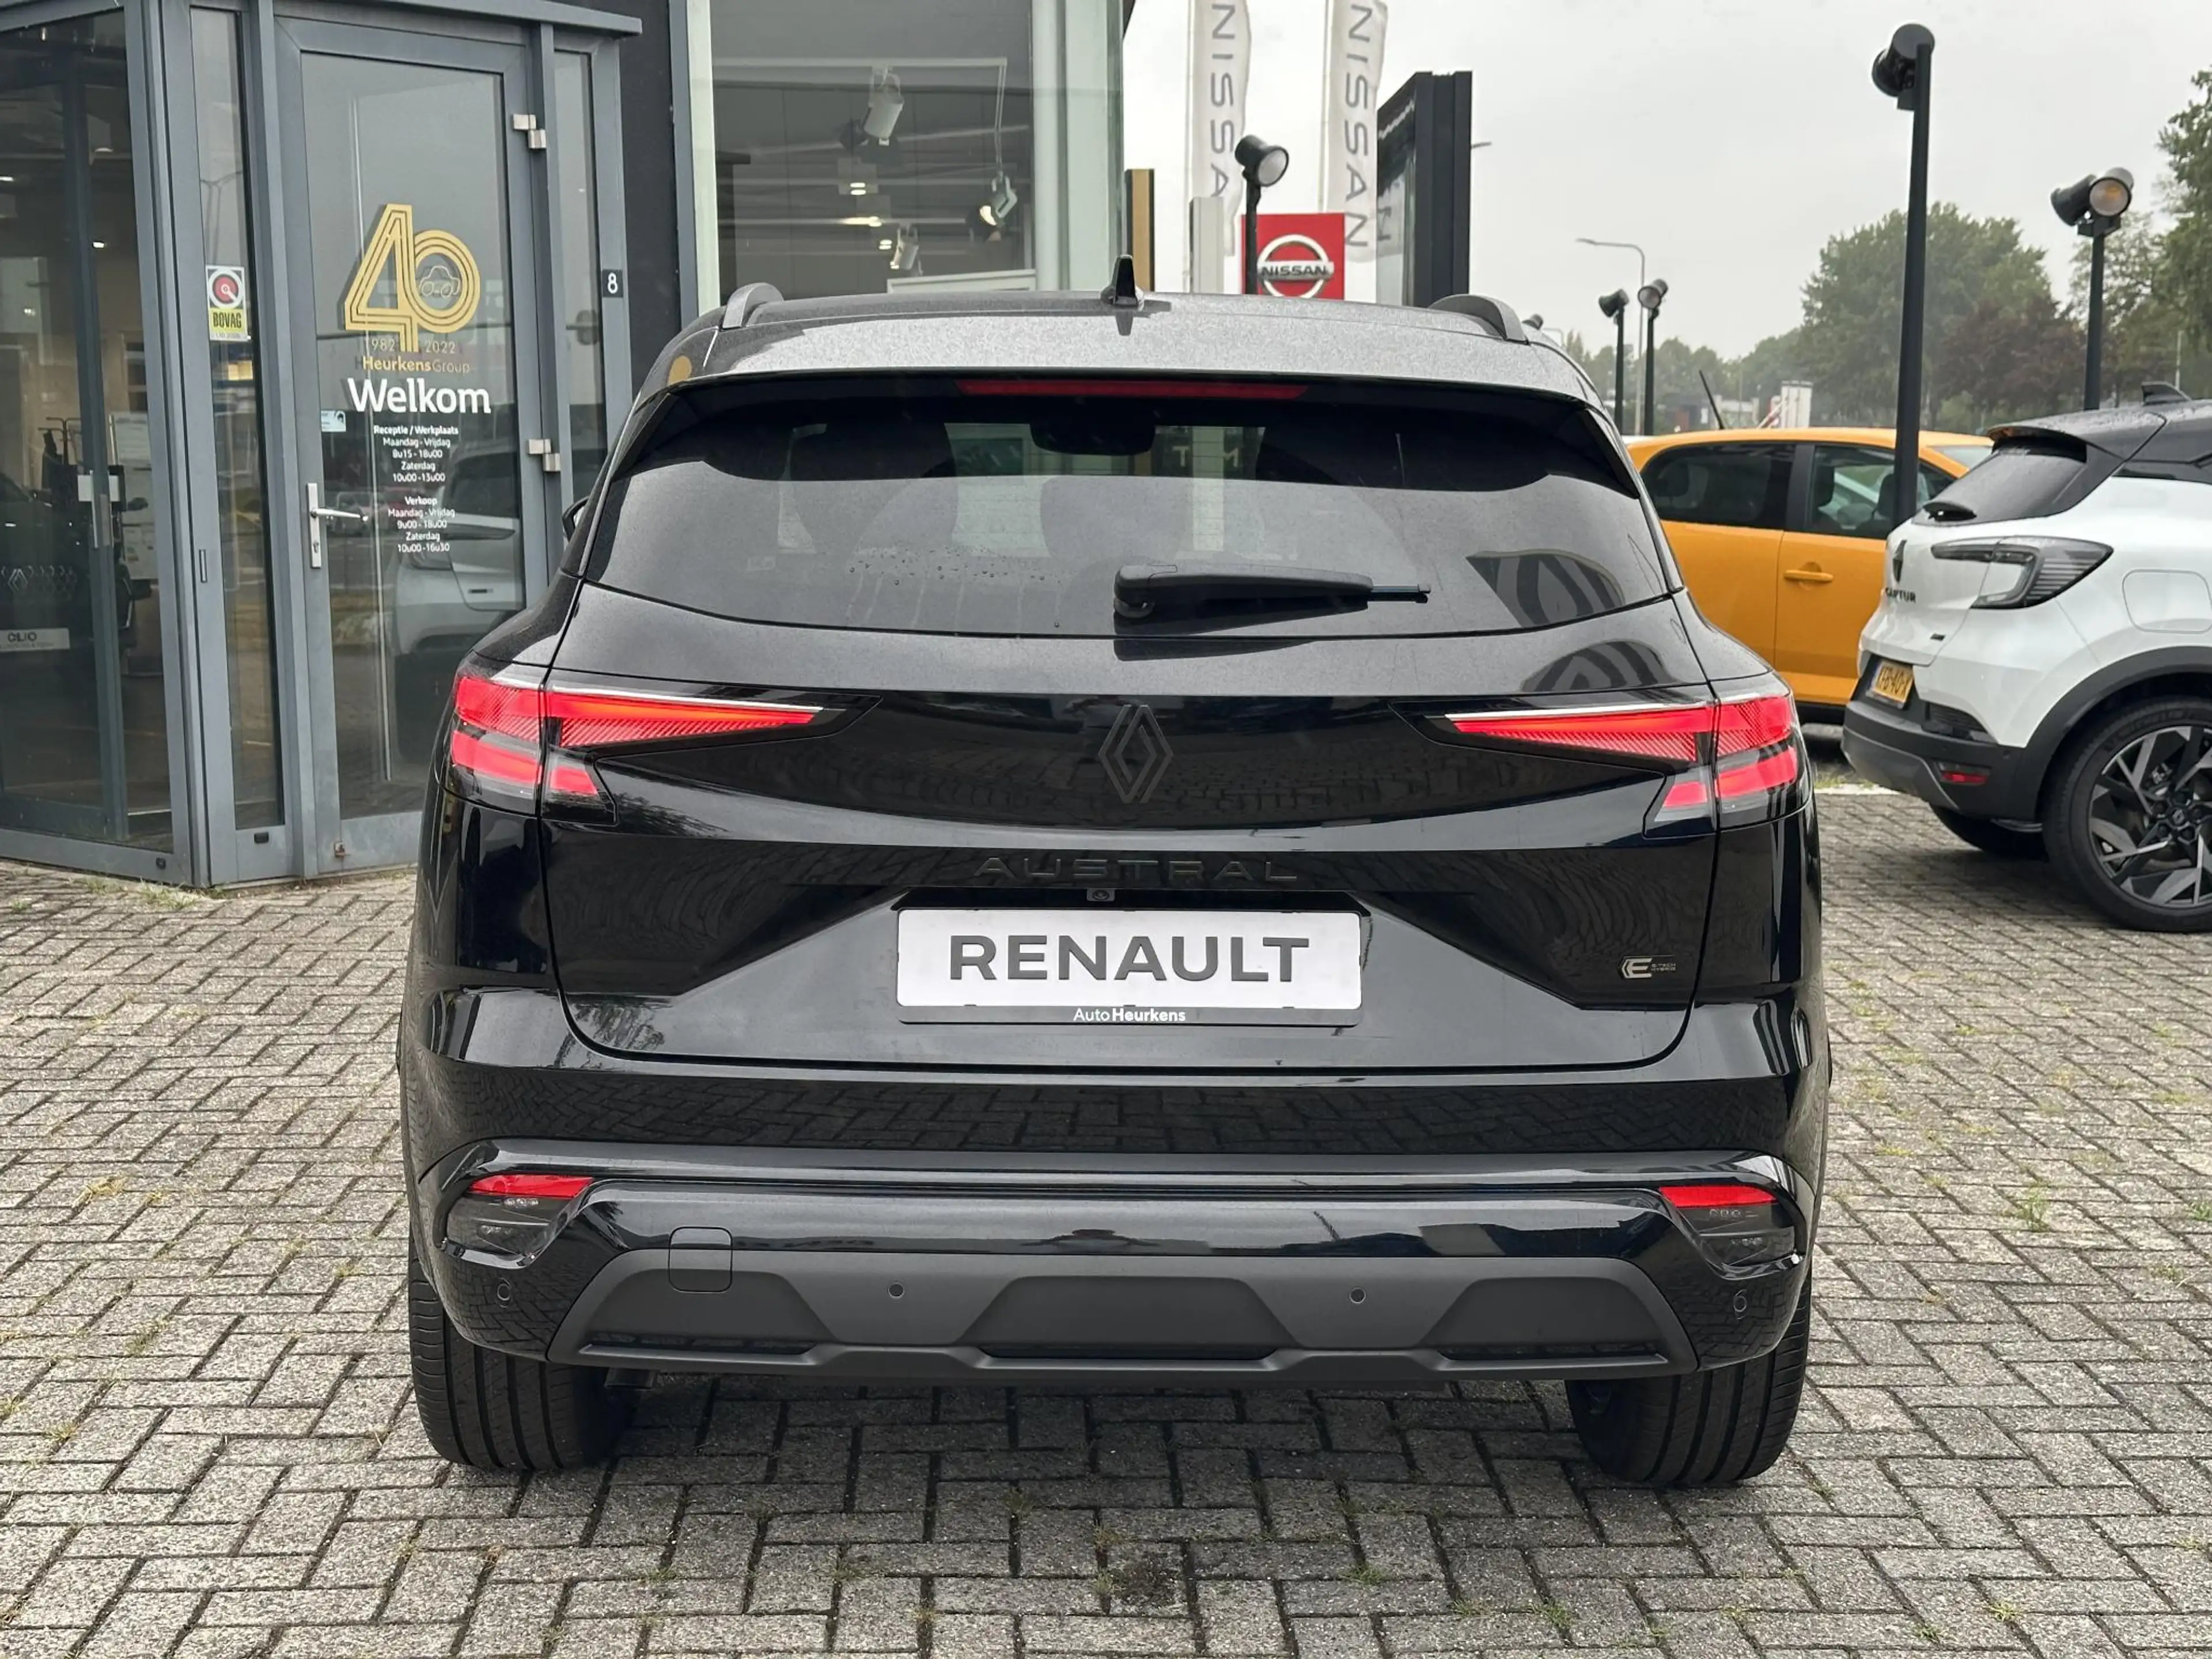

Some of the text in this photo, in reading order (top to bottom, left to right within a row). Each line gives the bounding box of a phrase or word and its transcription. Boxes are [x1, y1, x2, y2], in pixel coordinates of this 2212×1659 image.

[1210, 4, 1236, 197] NISSA
[1344, 4, 1372, 247] NISSAN
[344, 204, 480, 352] 40
[1262, 266, 1326, 277] NISSAN
[607, 272, 618, 294] 8
[213, 312, 242, 328] BOVAG
[425, 340, 456, 354] 2022
[362, 355, 470, 376] HeurkensGroup
[347, 377, 491, 414] Welkom
[373, 425, 408, 436] Receptie
[414, 425, 459, 436] Werkplaats
[382, 437, 419, 448] Maandag
[423, 437, 451, 448] Vrijdag
[401, 461, 436, 472] Zaterdag
[404, 495, 438, 506] Verkoop
[388, 508, 423, 518] Maandag
[429, 509, 456, 518] Vrijdag
[406, 531, 441, 542] Zaterdag
[7, 631, 37, 642] CLIO
[974, 857, 1298, 882] AUSTRAL
[949, 934, 1310, 983] RENAULT
[1073, 1007, 1186, 1022] Auto Heurkens
